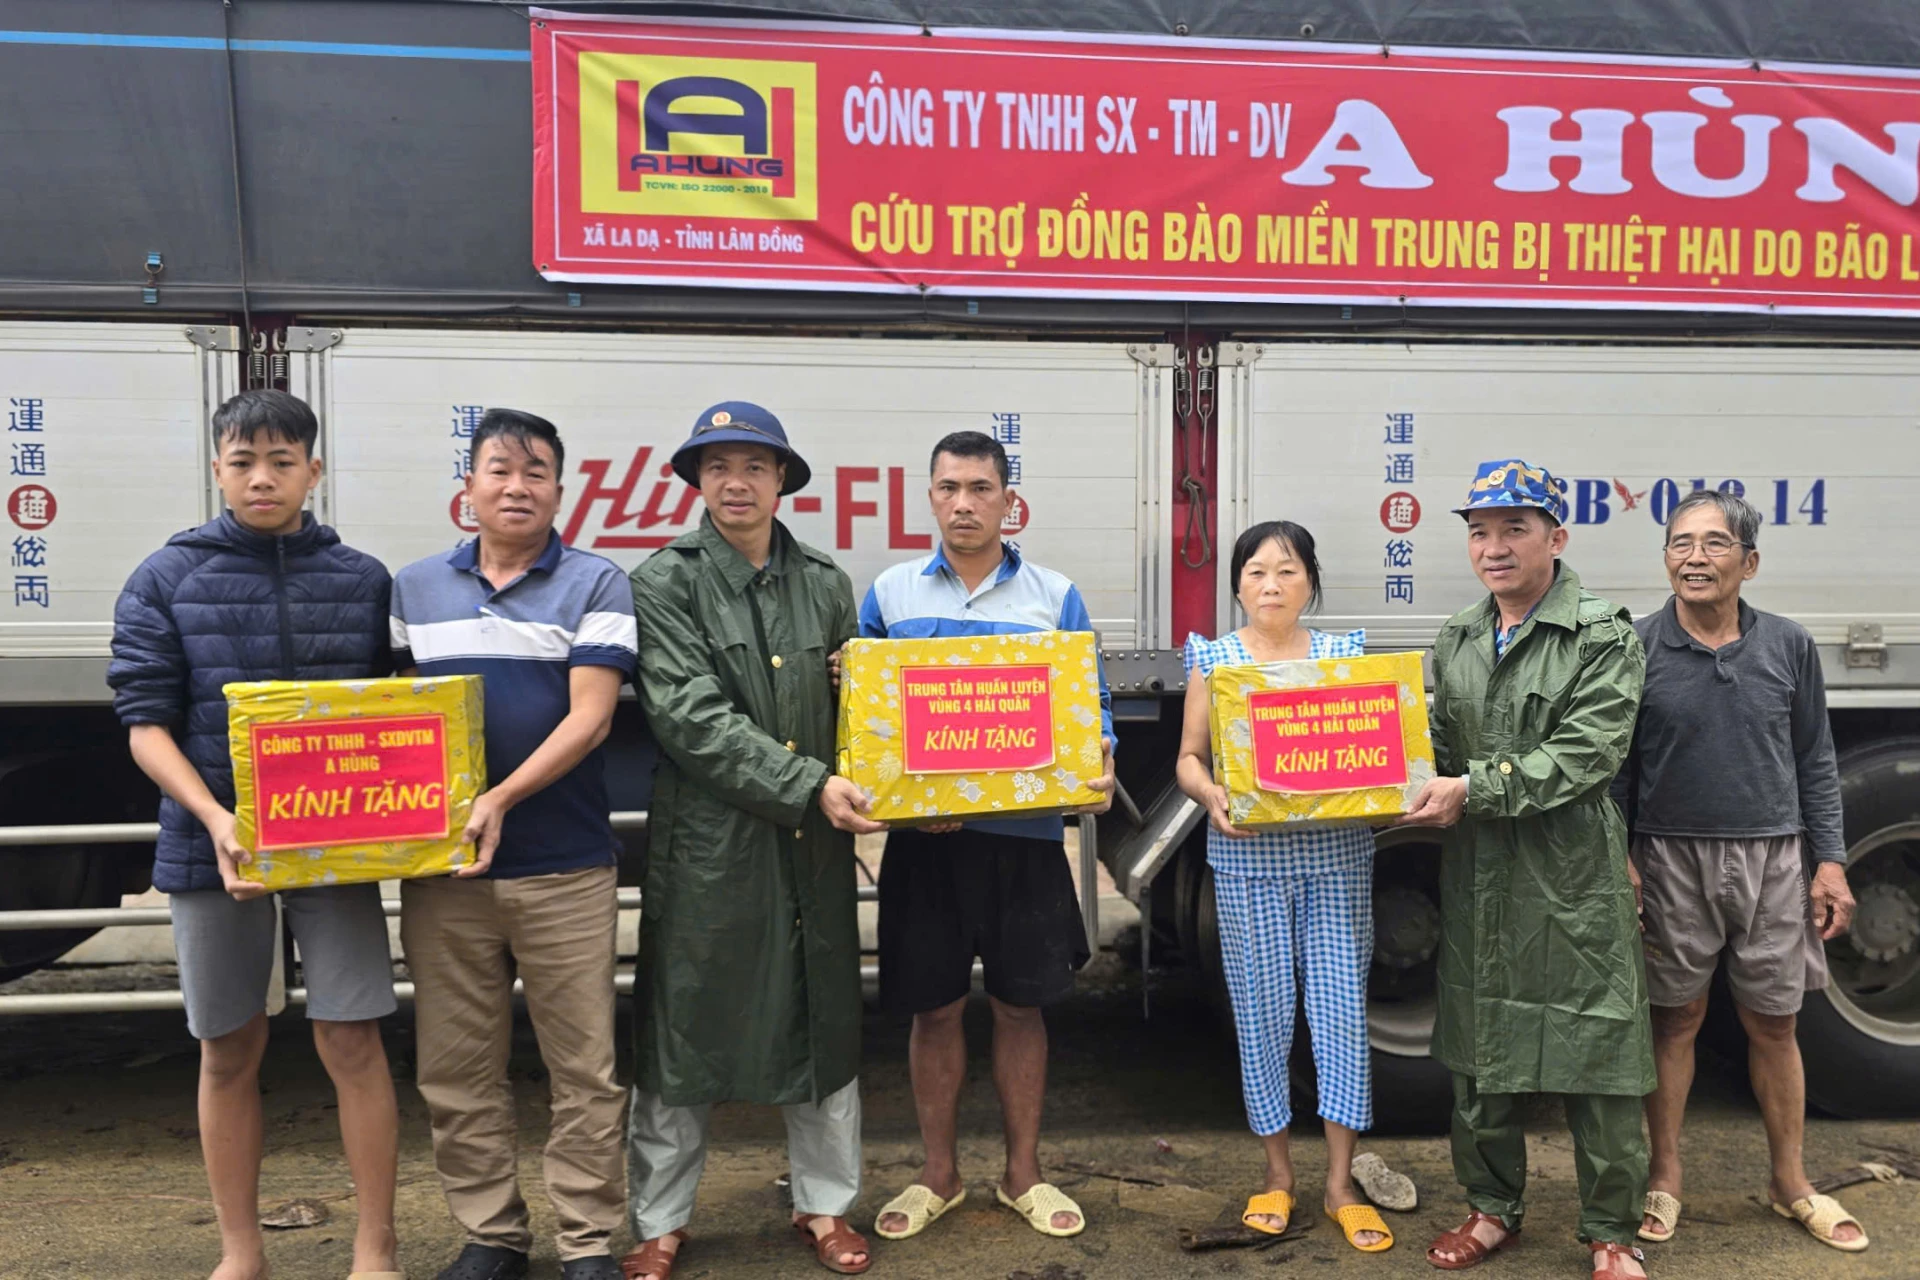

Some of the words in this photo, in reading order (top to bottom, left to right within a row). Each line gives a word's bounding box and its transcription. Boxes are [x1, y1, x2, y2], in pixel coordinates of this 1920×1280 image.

[843, 70, 934, 148] CÔNG
[943, 89, 986, 149] TY
[995, 91, 1084, 152] TNHH
[1096, 95, 1138, 154] SX
[1168, 99, 1217, 157] TM
[1250, 101, 1292, 159] DV
[1281, 99, 1434, 190] A
[703, 185, 735, 193] 22000
[583, 223, 606, 246] XÃ
[611, 228, 632, 247] LA
[637, 229, 660, 251] DẠ
[675, 224, 714, 249] TỈNH
[719, 227, 754, 251] LÂM
[759, 226, 804, 253] ĐỒNG
[851, 193, 934, 254] CỨU
[947, 202, 1026, 268] TRỢ
[1037, 192, 1149, 260] ĐỒNG
[1163, 202, 1242, 263] BÀO
[1256, 200, 1358, 266] MIỀN
[1371, 218, 1500, 269] TRUNG
[1513, 222, 1551, 281] BỊ
[1564, 214, 1667, 284] THIỆT
[1679, 226, 1740, 285] HẠI
[1754, 229, 1802, 277] DO
[1815, 222, 1888, 281] BÃO
[907, 682, 946, 696] TRUNG
[949, 678, 973, 695] TÂM
[976, 677, 1008, 695] HUẤN
[1011, 677, 1046, 696] LUYỆN
[929, 697, 961, 714] VÙNG
[963, 700, 972, 713] 4
[975, 696, 995, 712] HẢI
[999, 695, 1031, 713] QUÂN
[1254, 706, 1294, 720] TRUNG
[1296, 701, 1320, 717] TÂM
[1323, 697, 1356, 716] HUẤN
[1359, 696, 1395, 715] LUYỆN
[924, 725, 979, 751] KÍNH
[984, 724, 1037, 753] TẶNG
[1276, 719, 1309, 737] VÙNG
[1311, 721, 1320, 735] 4
[1322, 716, 1344, 734] HẢI
[1346, 714, 1380, 733] QUÂN
[261, 734, 302, 755] CÔNG
[305, 736, 322, 752] TY
[326, 733, 365, 750] TNHH
[378, 729, 435, 748] SXDVTM
[325, 757, 336, 774] A
[339, 752, 380, 773] HÙNG
[1275, 748, 1328, 774] KÍNH
[1334, 744, 1388, 773] TẶNG
[268, 785, 353, 820] KÍNH
[361, 779, 443, 818] TẶNG
